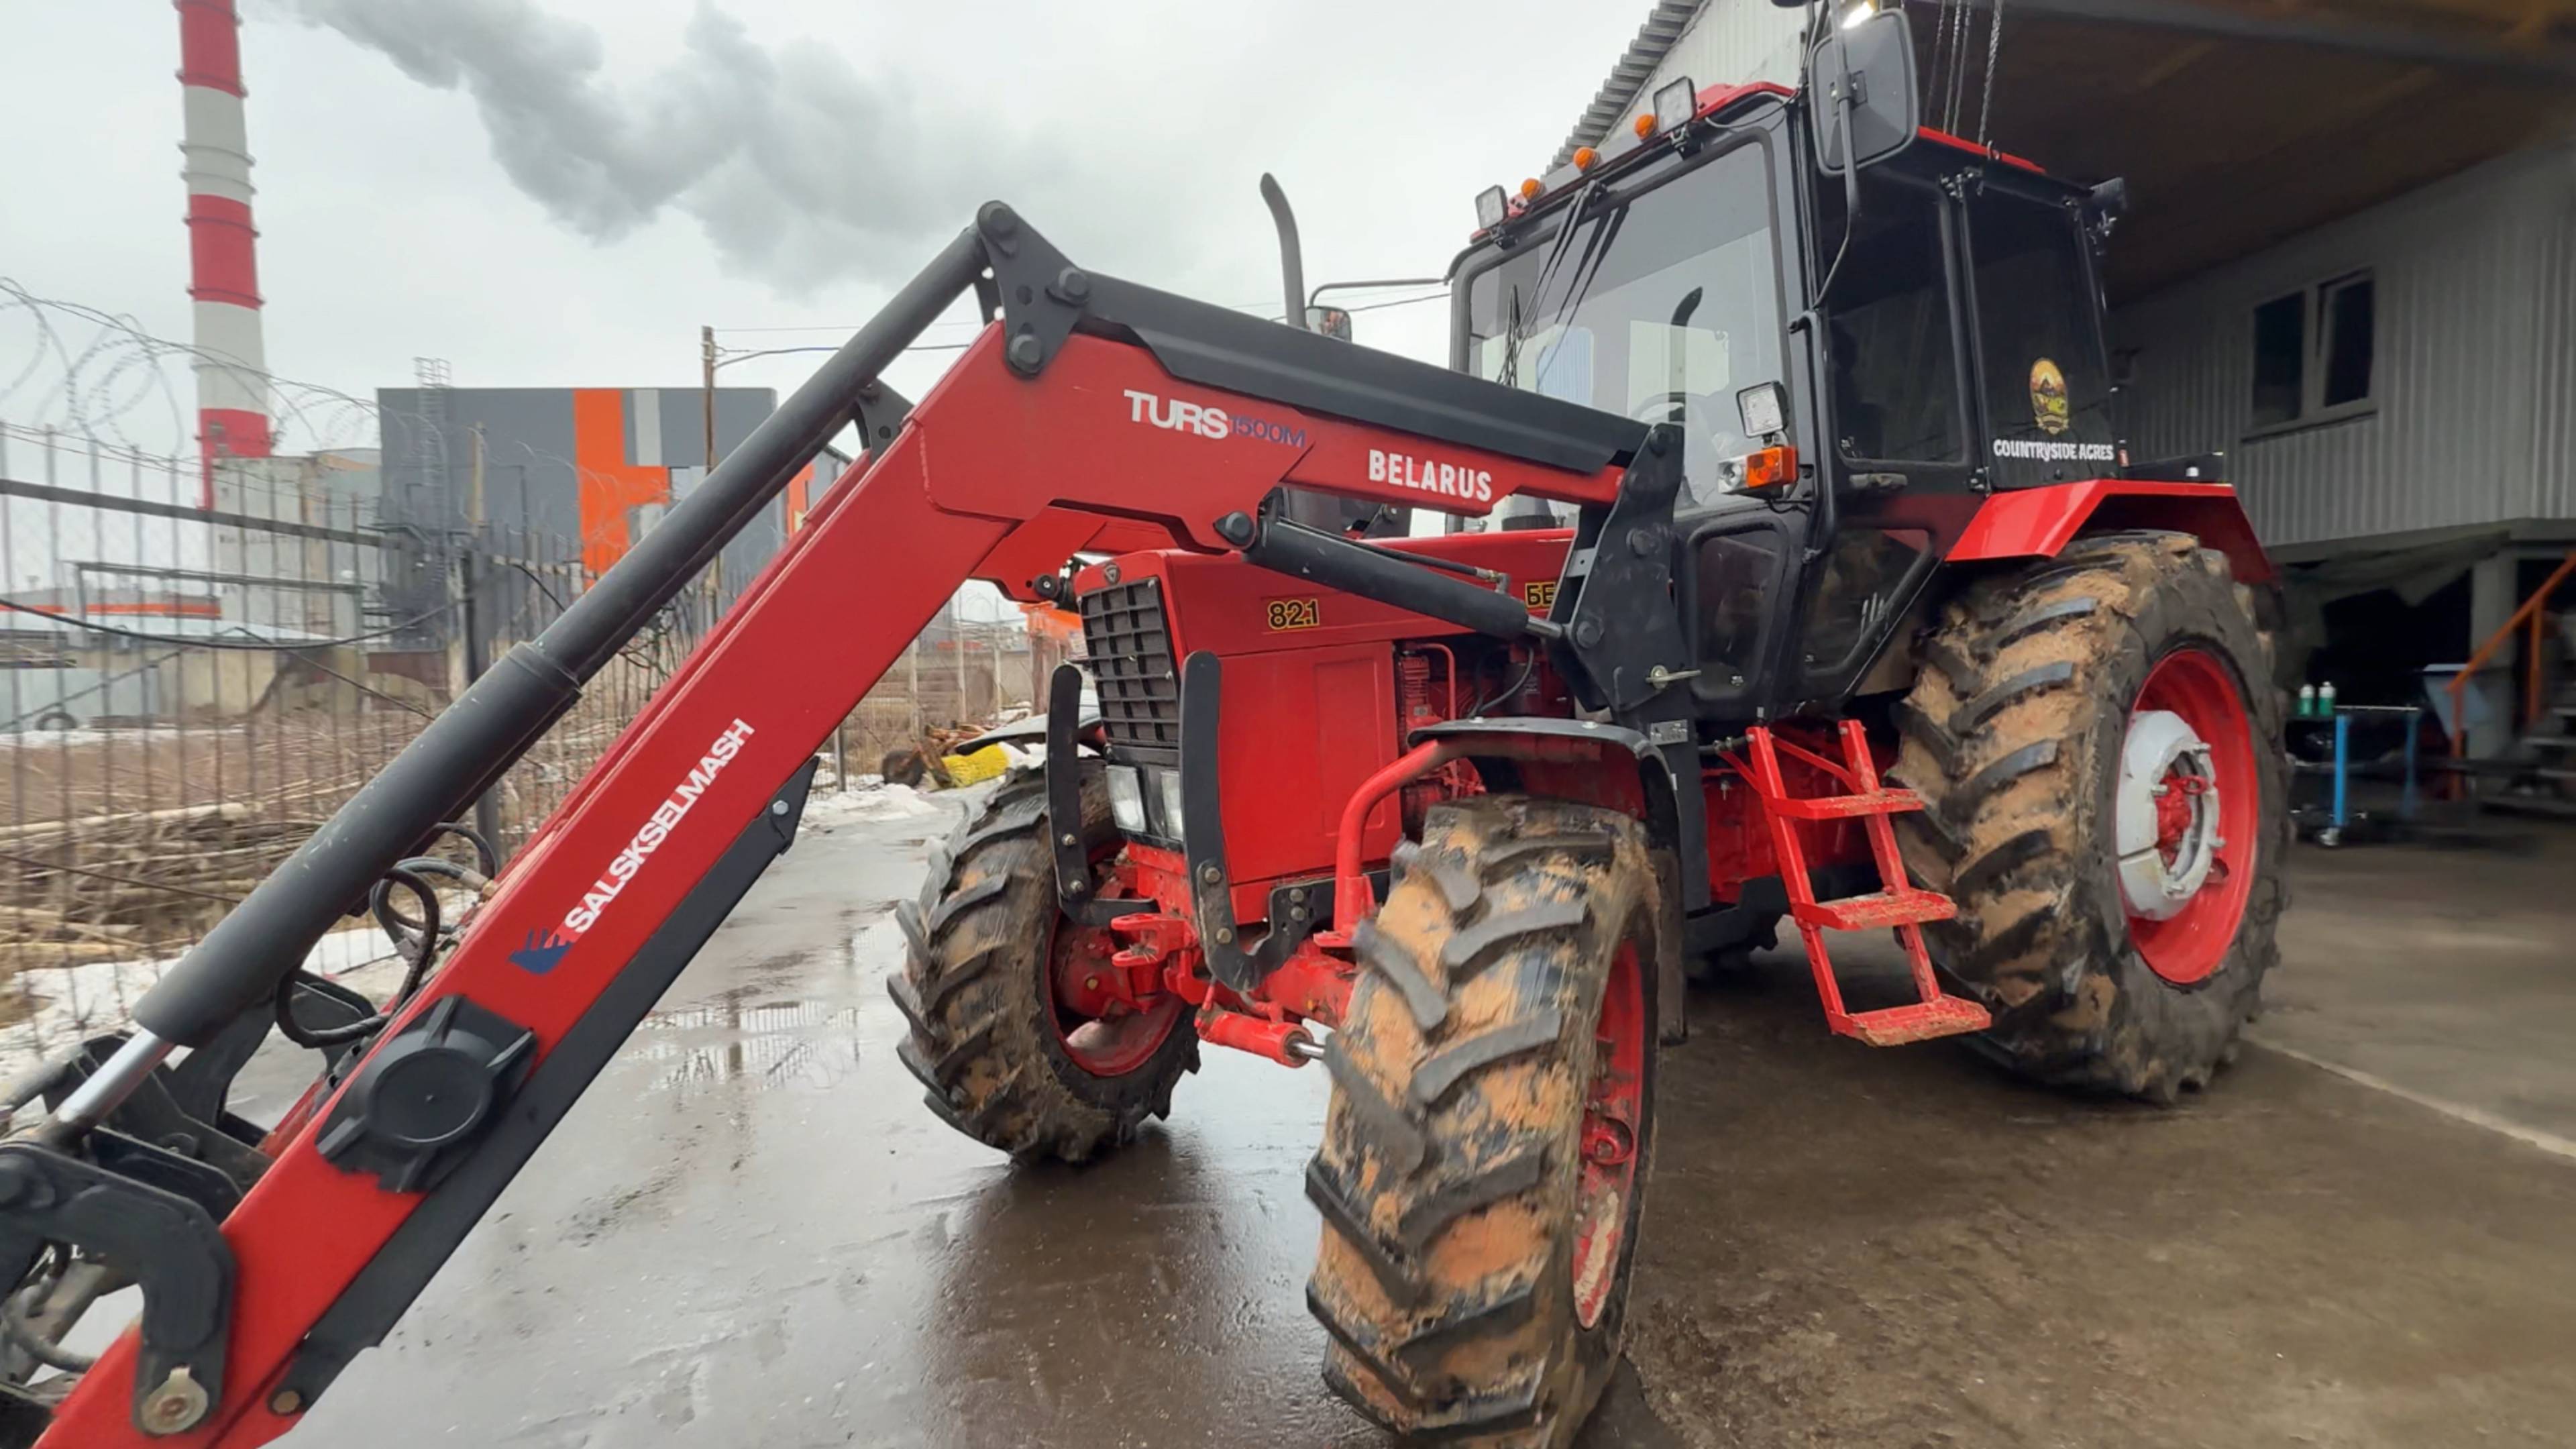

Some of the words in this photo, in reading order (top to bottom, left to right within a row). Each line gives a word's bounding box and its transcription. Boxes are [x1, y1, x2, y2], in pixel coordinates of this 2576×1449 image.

[1124, 388, 1229, 439] TURS
[1228, 414, 1306, 448] 1500M
[1368, 449, 1492, 502] BELARUS
[1993, 439, 2077, 462] COUNTRYSIDE
[2078, 443, 2114, 461] ACRES
[1267, 598, 1320, 630] 82.1
[564, 718, 755, 933] SALSKSELMASH
